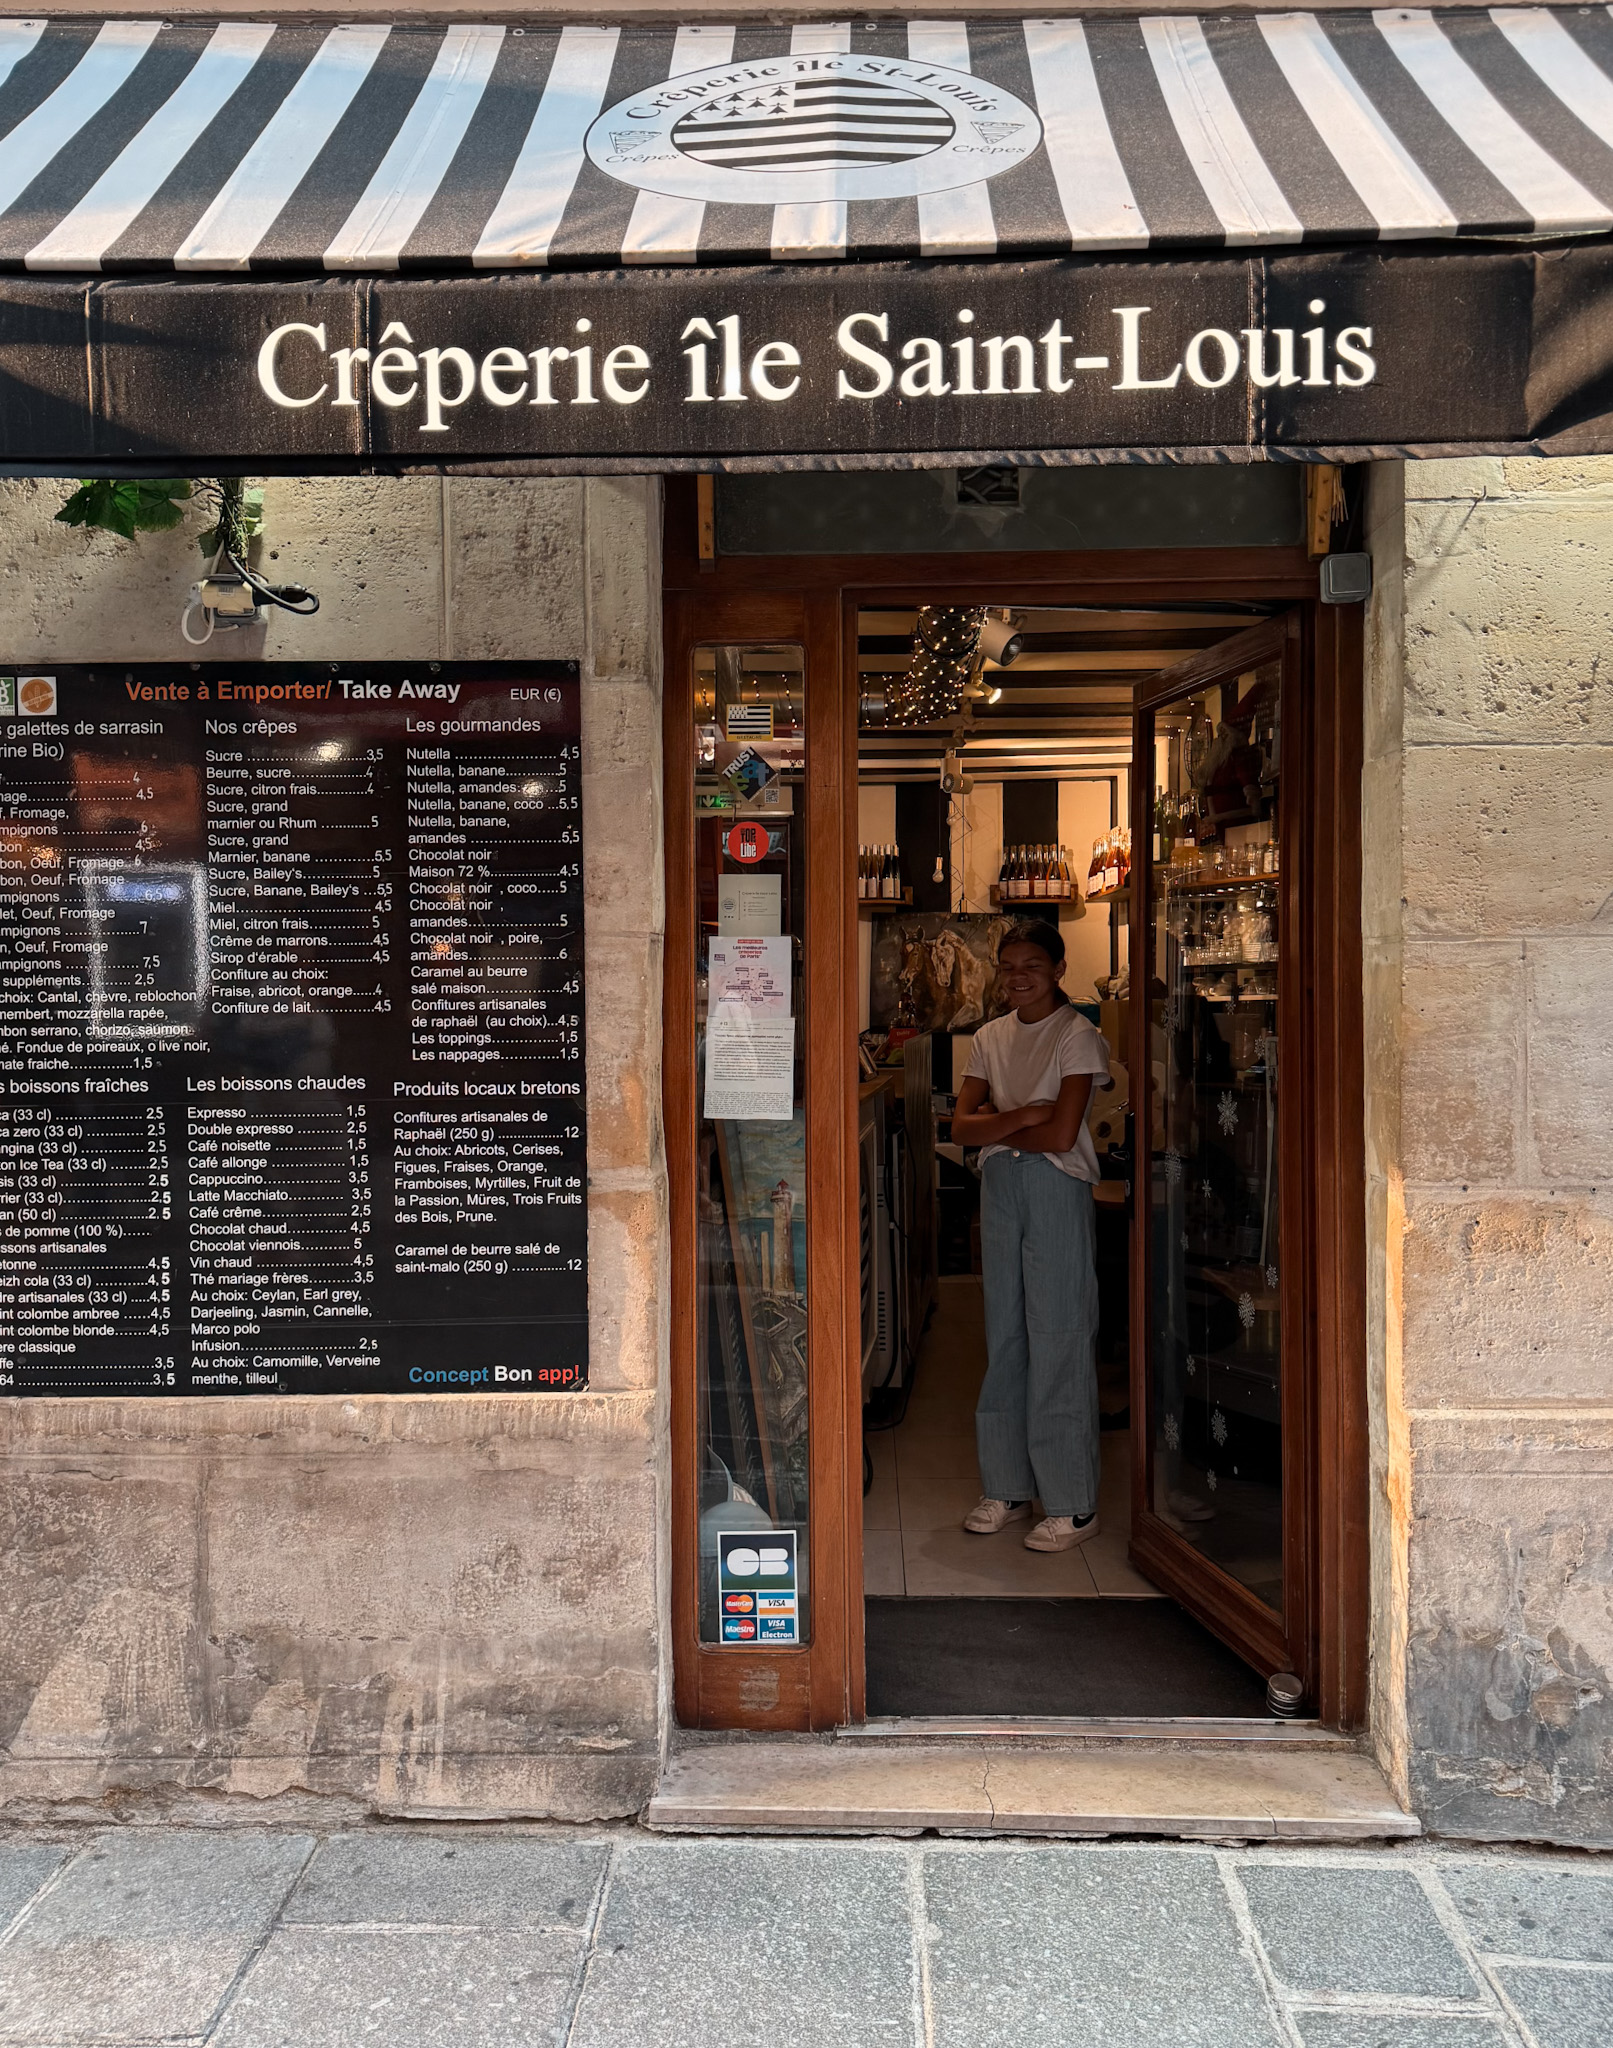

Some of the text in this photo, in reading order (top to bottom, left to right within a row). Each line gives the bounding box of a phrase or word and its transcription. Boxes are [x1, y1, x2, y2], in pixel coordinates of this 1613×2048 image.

[625, 59, 998, 121] Crêperie île St-Louis
[952, 143, 1026, 155] Crêpes
[605, 152, 681, 165] Crêpes
[257, 298, 1376, 432] Crêperie île Saint-Louis
[126, 680, 461, 703] Vente à Emporter/ Take Away
[511, 688, 561, 703] EUR (€)
[7, 720, 163, 737] galettes de sarrasin
[205, 719, 297, 737] Nos crêpes
[406, 718, 541, 735] Les gourmandes
[33, 743, 65, 759] Bio)
[206, 749, 383, 763] Sucre 3,5
[407, 747, 579, 760] Nutella 4,5
[407, 763, 566, 777] Nutella, banane 5
[722, 747, 755, 779] TRUST
[206, 766, 373, 780] Beurre, sucre 4
[207, 783, 374, 796] Sucre, citron frais 4
[408, 797, 578, 811] Nutella, banane, coco 5,5
[208, 816, 379, 829] marnier ou Rhum 5
[208, 849, 392, 863] Marnier, banane 5,5
[409, 864, 579, 877] Maison 72 % 4,5
[209, 900, 391, 913] Miel 4,5
[15, 941, 108, 954] Oeuf, Fromage
[256, 936, 272, 946] de
[276, 937, 328, 946] marrons
[373, 934, 390, 947] 4,5
[411, 966, 527, 977] Caramel au beurre
[3, 974, 155, 988] suppléments 2,5
[411, 981, 579, 994] salé maison 4,5
[37, 991, 82, 1003] Cantal,
[212, 984, 382, 998] Fraise, abricot, orange 4
[212, 1000, 391, 1014] Confiture de lait 4,5
[412, 1032, 578, 1046] Les toppings 1,5
[412, 1048, 579, 1062] Les nappages 1,5
[10, 1078, 148, 1093] boissons fraîches
[187, 1075, 366, 1091] Les boissons chaudes
[394, 1081, 580, 1096] Produits locaux bretons
[188, 1105, 366, 1120] Expresso 1,5
[394, 1111, 548, 1123] Confitures artisanales de
[13, 1123, 165, 1139] zero (33 cl) 2,5
[188, 1122, 367, 1136] Double expresso 2,5
[394, 1127, 579, 1142] Raphaël (250 g) 12
[189, 1172, 368, 1187] Cappuccino 3,5
[25, 1225, 123, 1239] pomme (100 %)
[190, 1221, 370, 1235] Chocolat chaud 4,5
[190, 1254, 374, 1268] Vin chaud 4,5
[395, 1259, 582, 1274] saint-malo (250 g) 12
[17, 1308, 170, 1320] colombe ambree 4,5
[191, 1305, 372, 1320] Darjeeling, Jasmin, Cannelle,
[19, 1341, 76, 1355] classique
[192, 1373, 278, 1385] menthe, tilleul
[409, 1365, 579, 1385] Concept Bon app!
[727, 1548, 789, 1576] CB
[725, 1625, 754, 1633] Maestro
